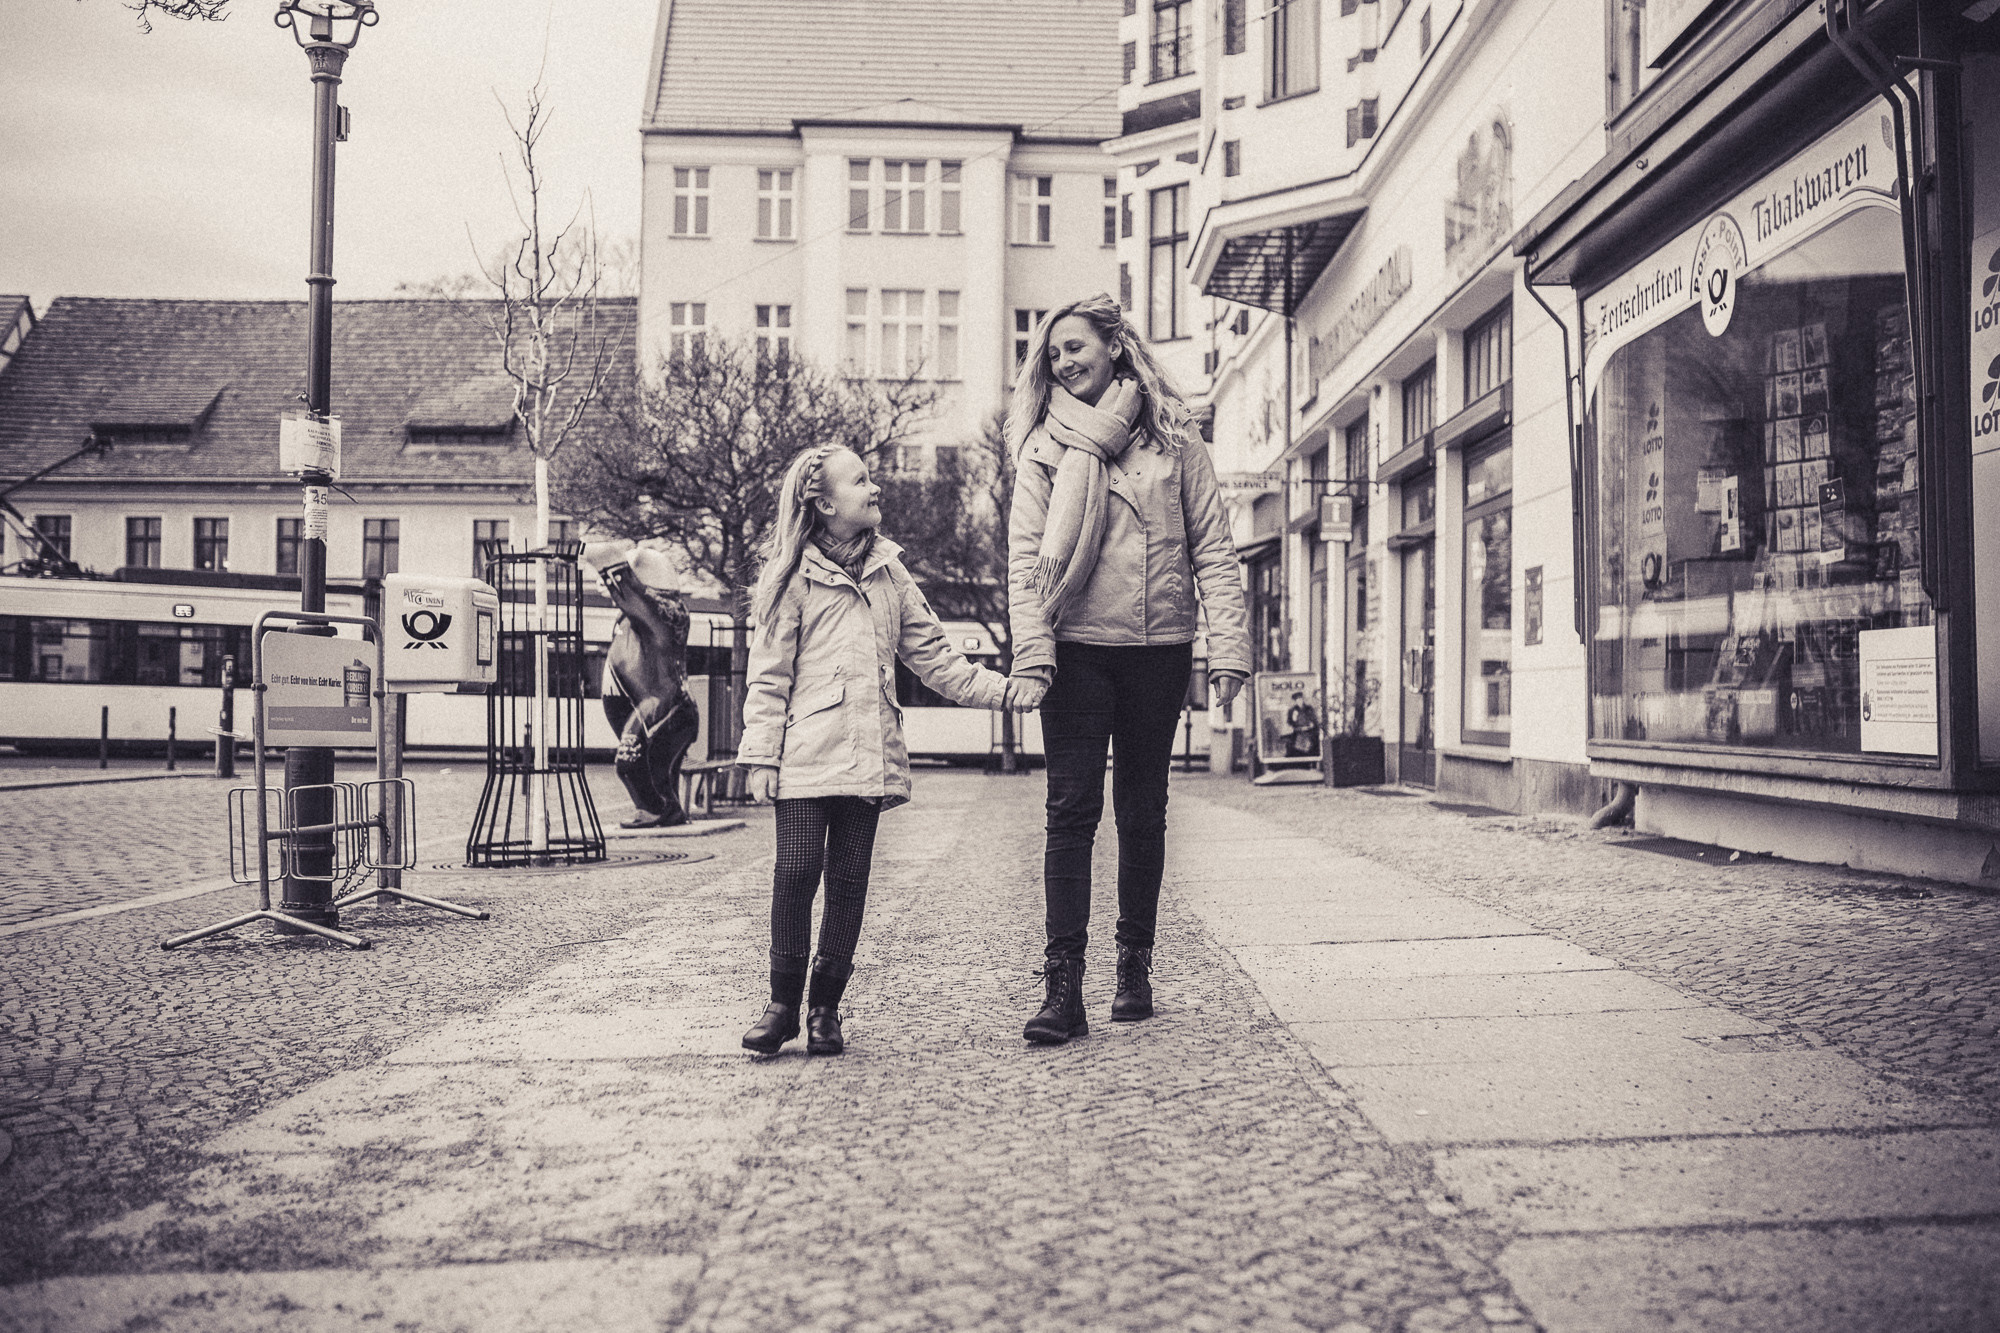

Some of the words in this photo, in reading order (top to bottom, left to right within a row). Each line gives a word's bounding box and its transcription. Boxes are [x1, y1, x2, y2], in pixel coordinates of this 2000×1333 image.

[1751, 143, 1868, 242] Tabakwaren
[1693, 236, 1711, 293] Post
[1719, 220, 1743, 270] Point
[1600, 266, 1683, 337] Zeitschriften
[1643, 436, 1663, 456] LOTTO
[1643, 506, 1662, 525] LOTTO
[271, 673, 281, 684] Echt
[290, 674, 301, 685] Echt
[301, 677, 309, 686] von
[318, 676, 328, 687] Echt
[328, 677, 342, 688] Kurier.
[346, 671, 369, 681] BERLINER
